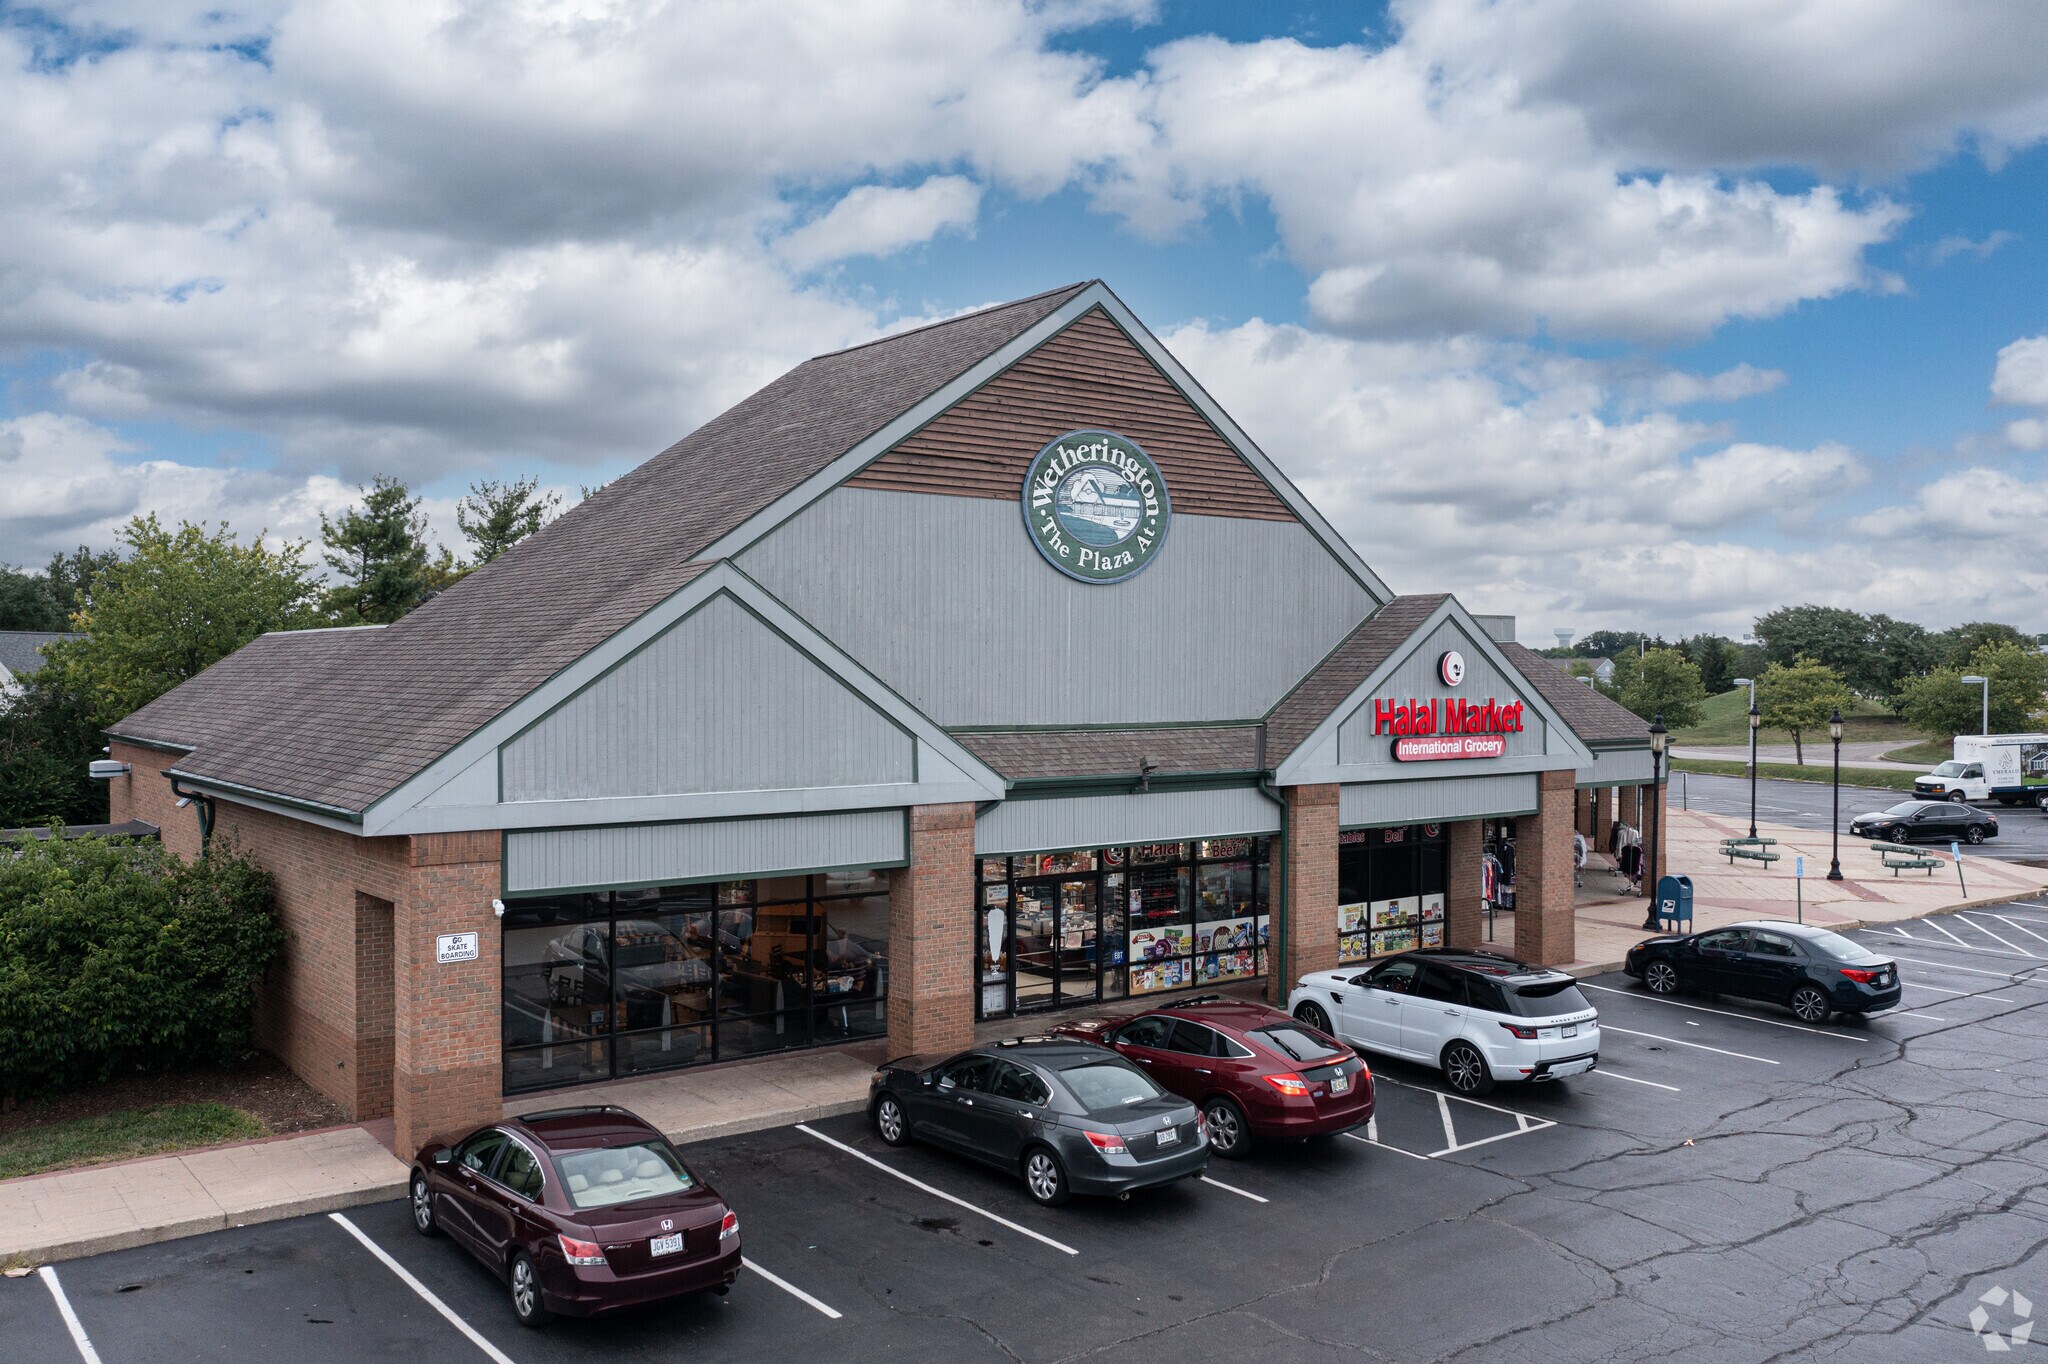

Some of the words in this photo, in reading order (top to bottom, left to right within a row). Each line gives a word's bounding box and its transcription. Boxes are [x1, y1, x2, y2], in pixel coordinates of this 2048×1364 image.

[1032, 438, 1160, 518] Wetherington
[1040, 516, 1070, 558] The
[1077, 547, 1134, 571] Plaza
[1136, 526, 1156, 554] At
[1374, 698, 1437, 735] Halal
[1445, 697, 1524, 734] Market
[1399, 740, 1462, 755] International
[1464, 739, 1503, 754] Grocery
[1385, 829, 1403, 843] Deli
[1212, 844, 1237, 857] Beef
[441, 950, 474, 959] BOARDING
[1114, 951, 1124, 959] EBT
[665, 1237, 680, 1248] 5391
